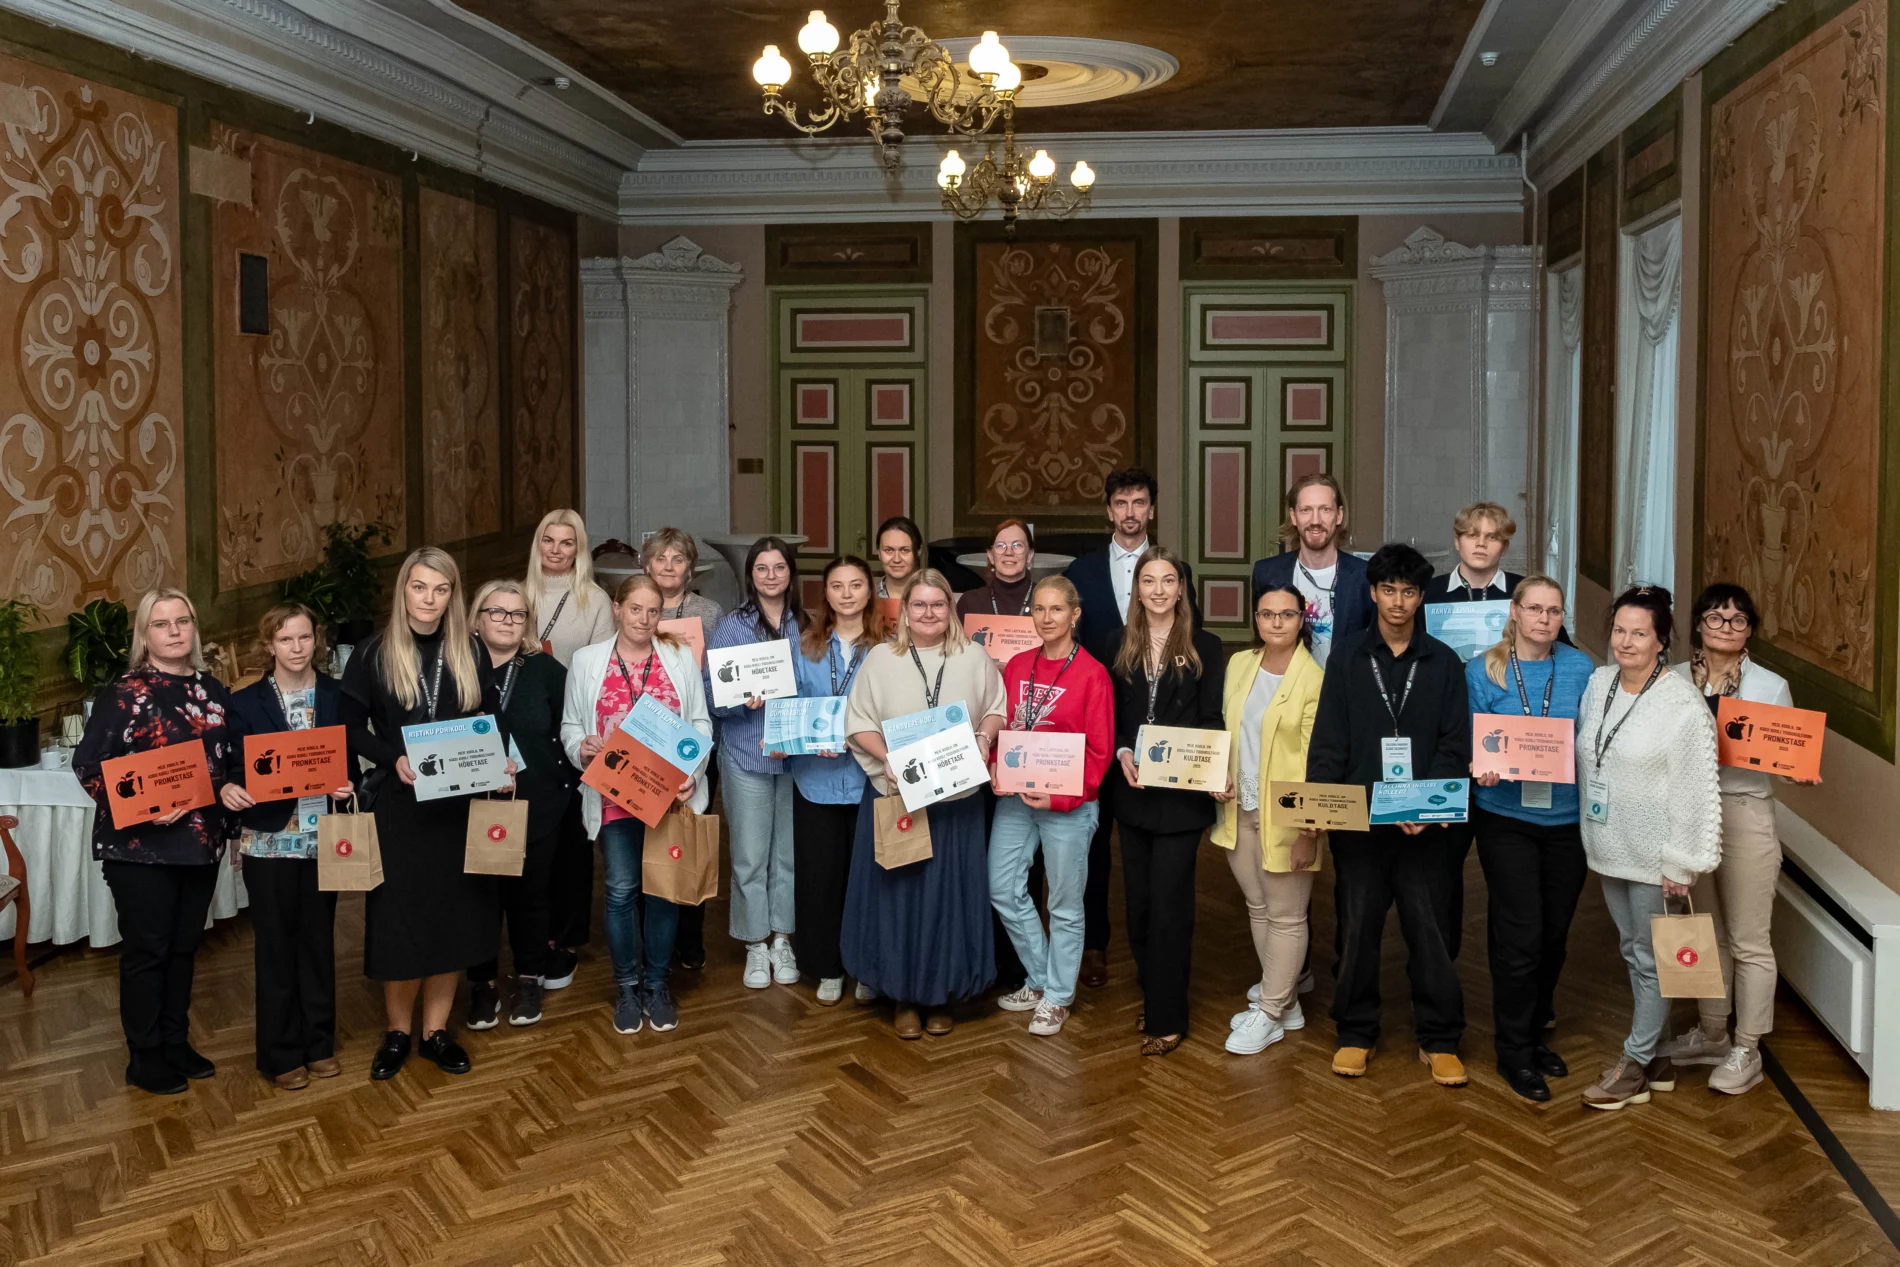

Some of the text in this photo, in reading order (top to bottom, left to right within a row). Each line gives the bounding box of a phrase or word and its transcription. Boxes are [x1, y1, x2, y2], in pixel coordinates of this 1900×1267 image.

[408, 728, 434, 738] RISTIKU
[1763, 734, 1807, 748] PRONKSTASE
[1519, 744, 1560, 753] PRONKSTASE
[292, 756, 332, 768] PRONKSTASE
[1036, 759, 1071, 767] PRONKSTASE
[1183, 755, 1212, 763] KULDTASE
[154, 771, 195, 787] PRONKSTASE
[631, 772, 662, 797] PRONKSTASE
